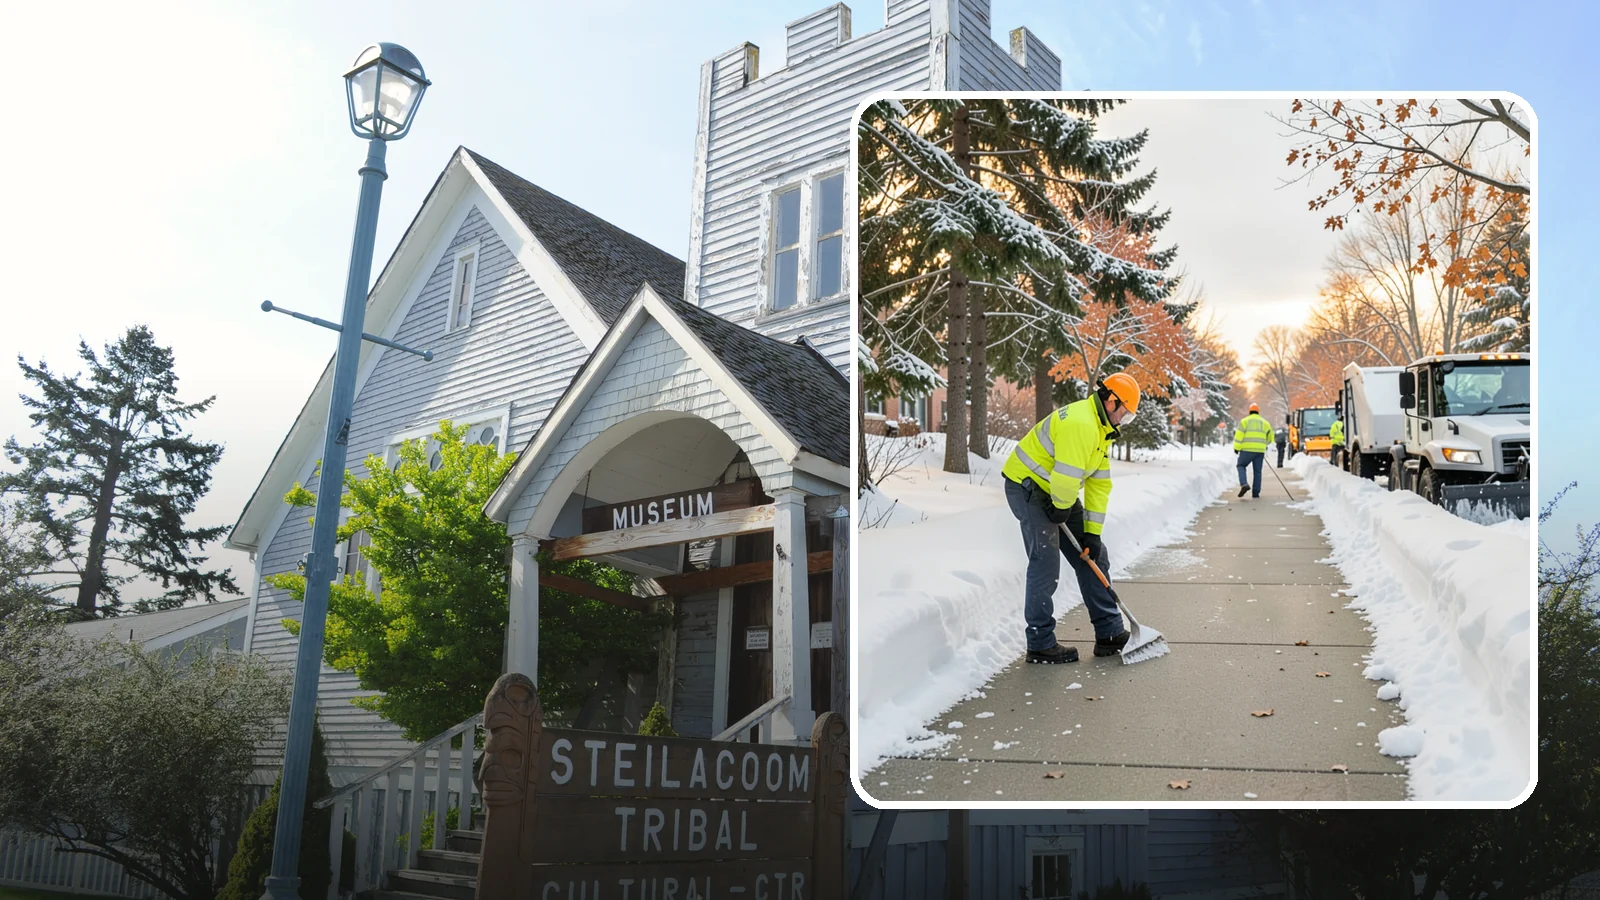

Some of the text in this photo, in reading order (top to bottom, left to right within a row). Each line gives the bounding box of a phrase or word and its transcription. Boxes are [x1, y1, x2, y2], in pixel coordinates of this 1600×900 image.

[612, 491, 714, 531] MUSEUM
[550, 737, 809, 793] STEILACOOM
[614, 806, 758, 852] TRIBAL
